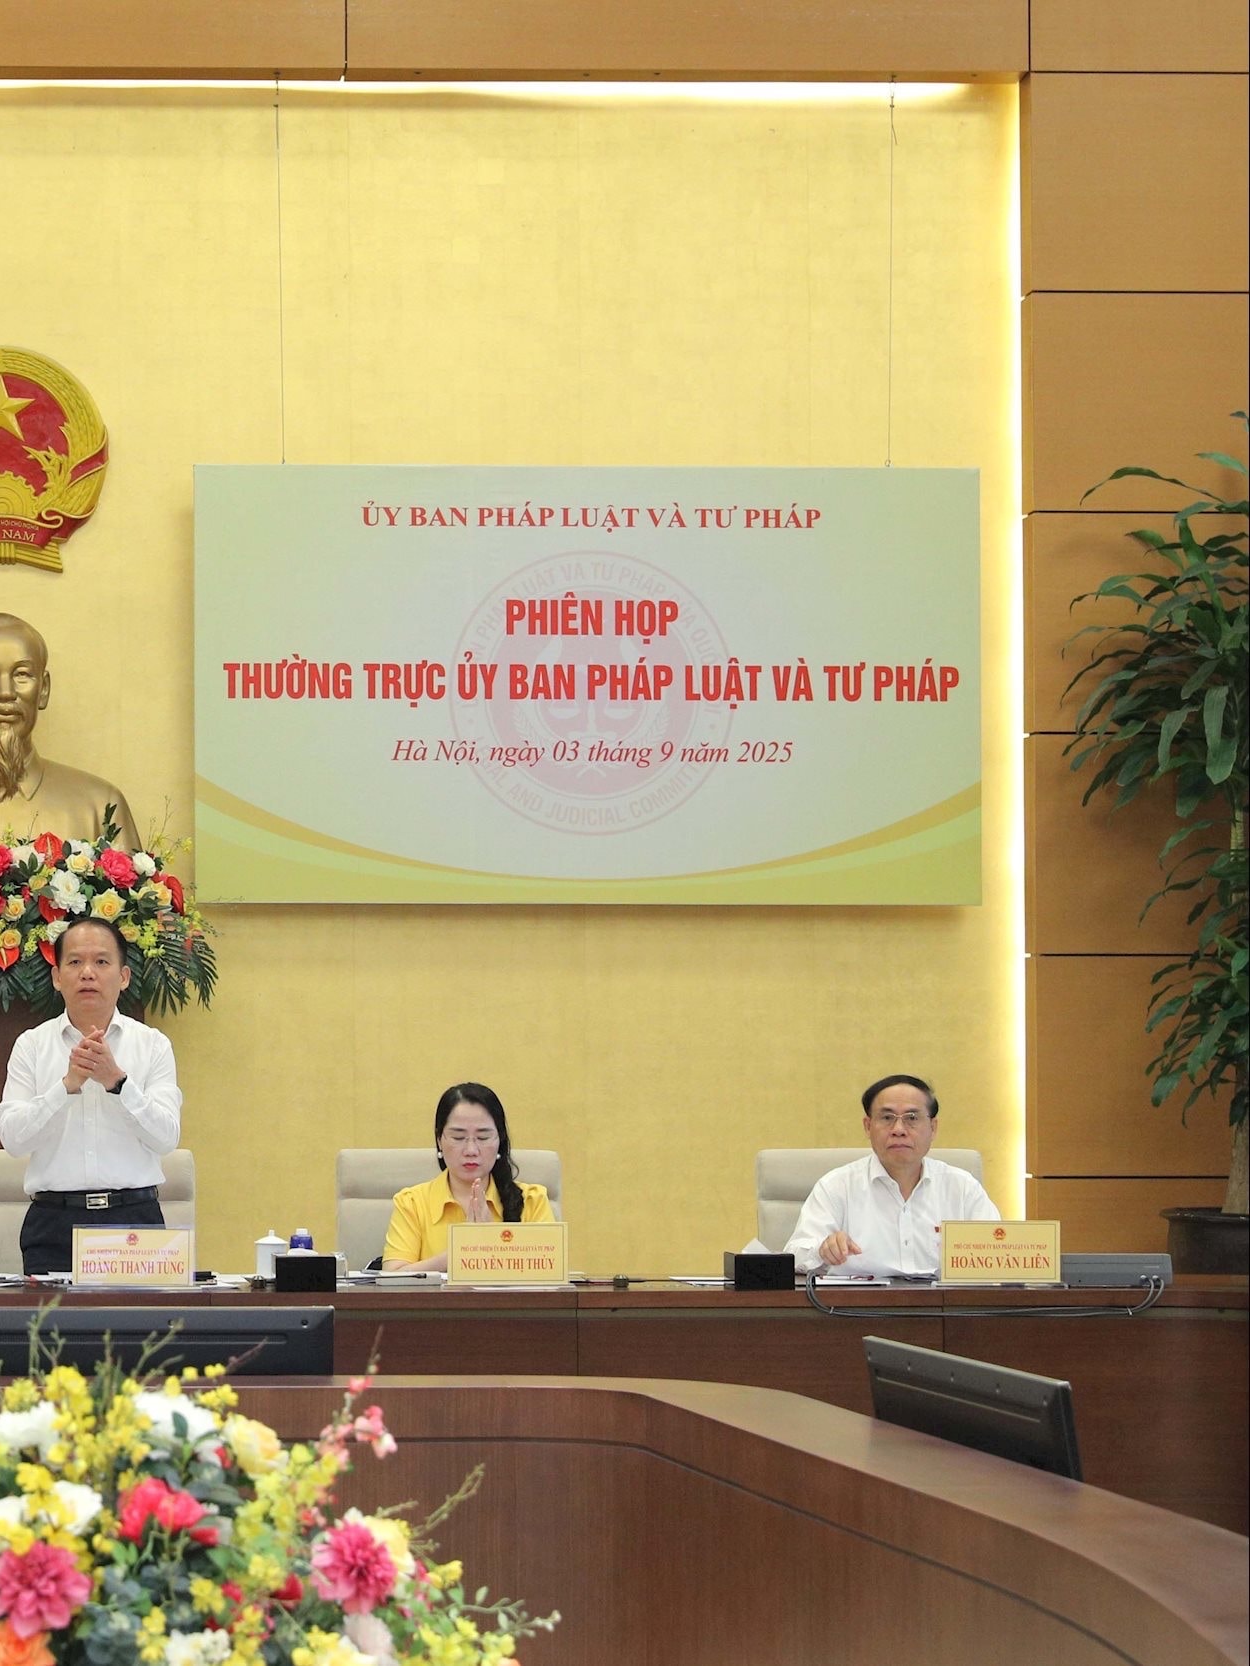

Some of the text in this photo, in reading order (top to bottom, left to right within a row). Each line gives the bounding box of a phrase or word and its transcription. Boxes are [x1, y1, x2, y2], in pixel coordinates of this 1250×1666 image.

[361, 500, 821, 533] ỦY BAN PHÁP LUẬT VÀ TƯ PHÁP
[2, 529, 36, 542] NAM
[505, 591, 602, 635] PHIÊN
[614, 599, 679, 645] HỌP
[223, 653, 352, 699] THƯỜNG
[363, 660, 446, 708] TRỰC
[457, 651, 498, 700] ỦY
[509, 664, 575, 700] BAN
[587, 657, 673, 701] PHÁP
[685, 657, 762, 710] LUẬT
[772, 658, 814, 701] VÀ
[823, 662, 866, 702] TƯ
[873, 658, 960, 702] PHÁP
[391, 739, 428, 761] Hà
[434, 740, 480, 766] Nội,
[489, 740, 545, 768] ngày
[552, 740, 580, 762] 03
[588, 740, 652, 768] tháng
[659, 741, 674, 763] 9
[680, 742, 729, 763] năm
[737, 741, 793, 763] 2025
[81, 1257, 184, 1274] HOÀNG THANH TÙNG
[507, 1258, 524, 1272] THỊ
[951, 1253, 1050, 1268] HOÀNG VĂN LIÊN
